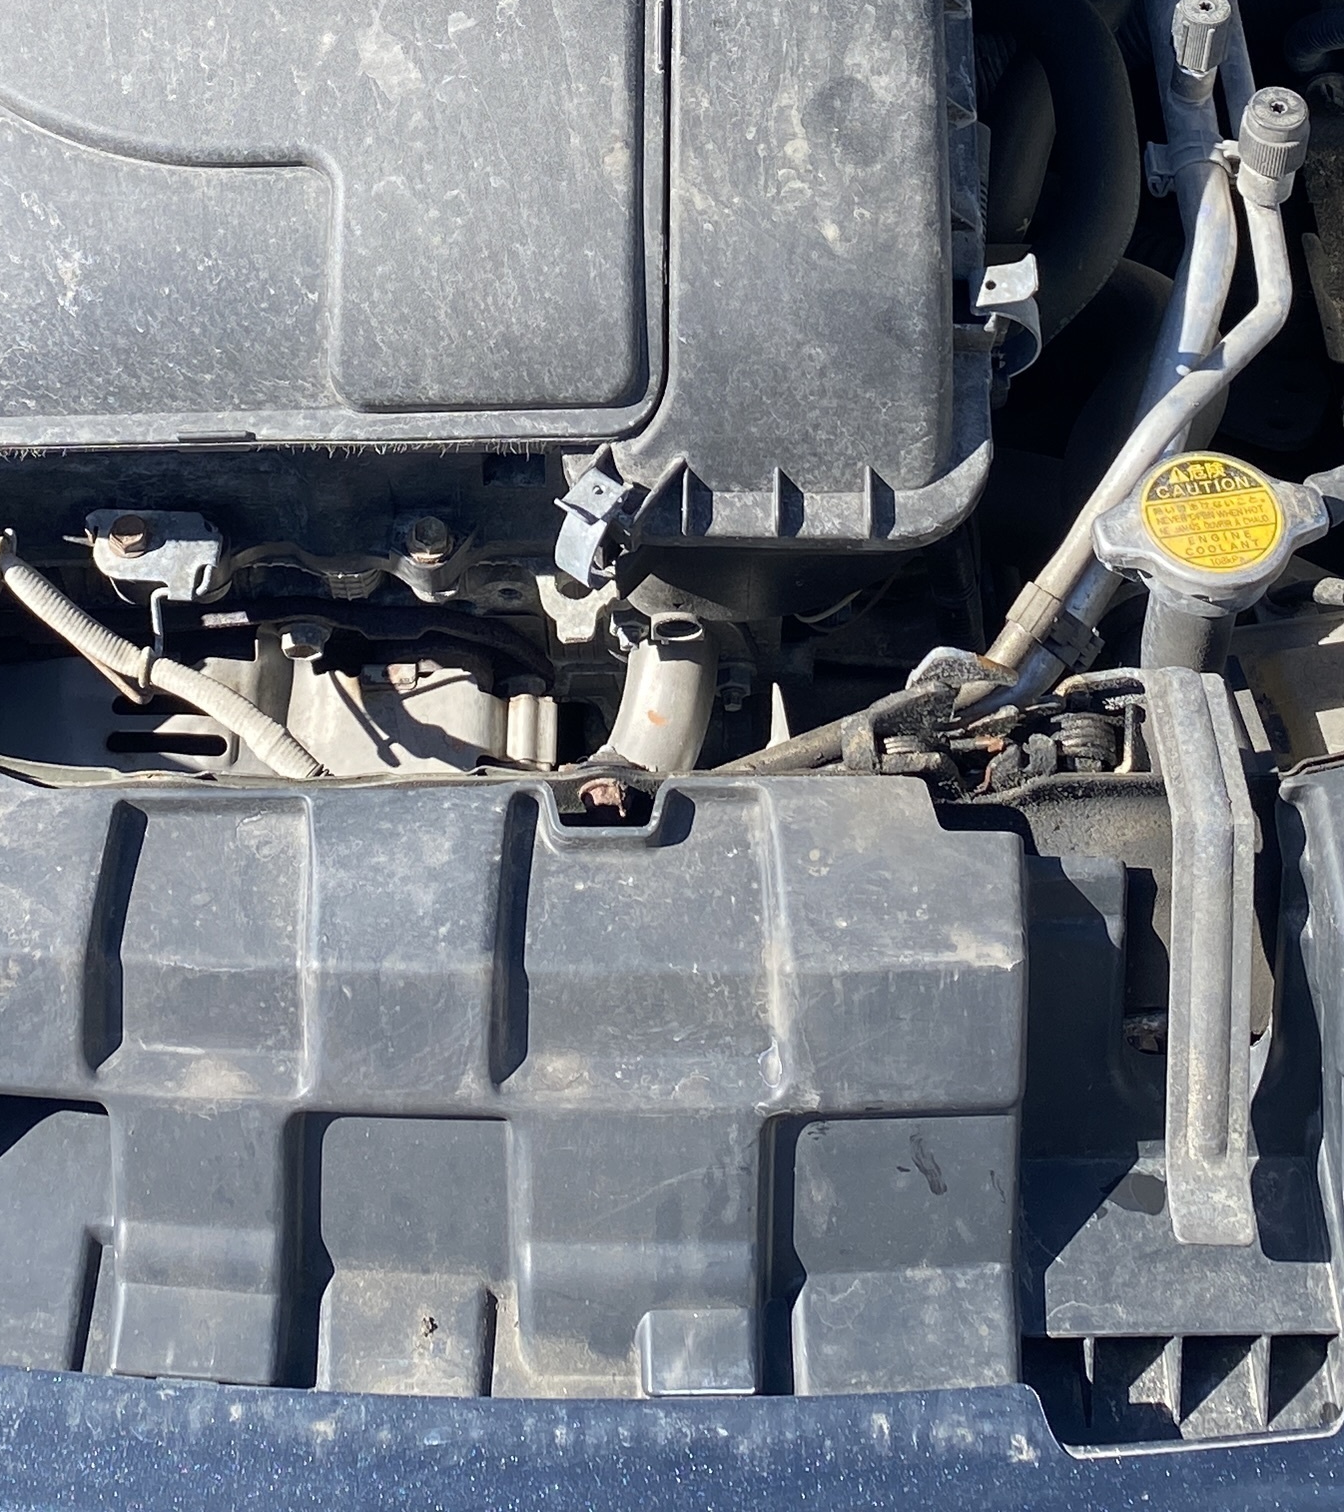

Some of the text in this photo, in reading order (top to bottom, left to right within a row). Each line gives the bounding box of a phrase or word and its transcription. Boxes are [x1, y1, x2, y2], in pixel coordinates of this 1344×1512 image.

[1188, 462, 1226, 480] 危険
[1156, 476, 1250, 498] CAUTION
[1244, 504, 1264, 516] HOT
[1188, 530, 1252, 546] ENGINE
[1185, 539, 1260, 556] COOLANT
